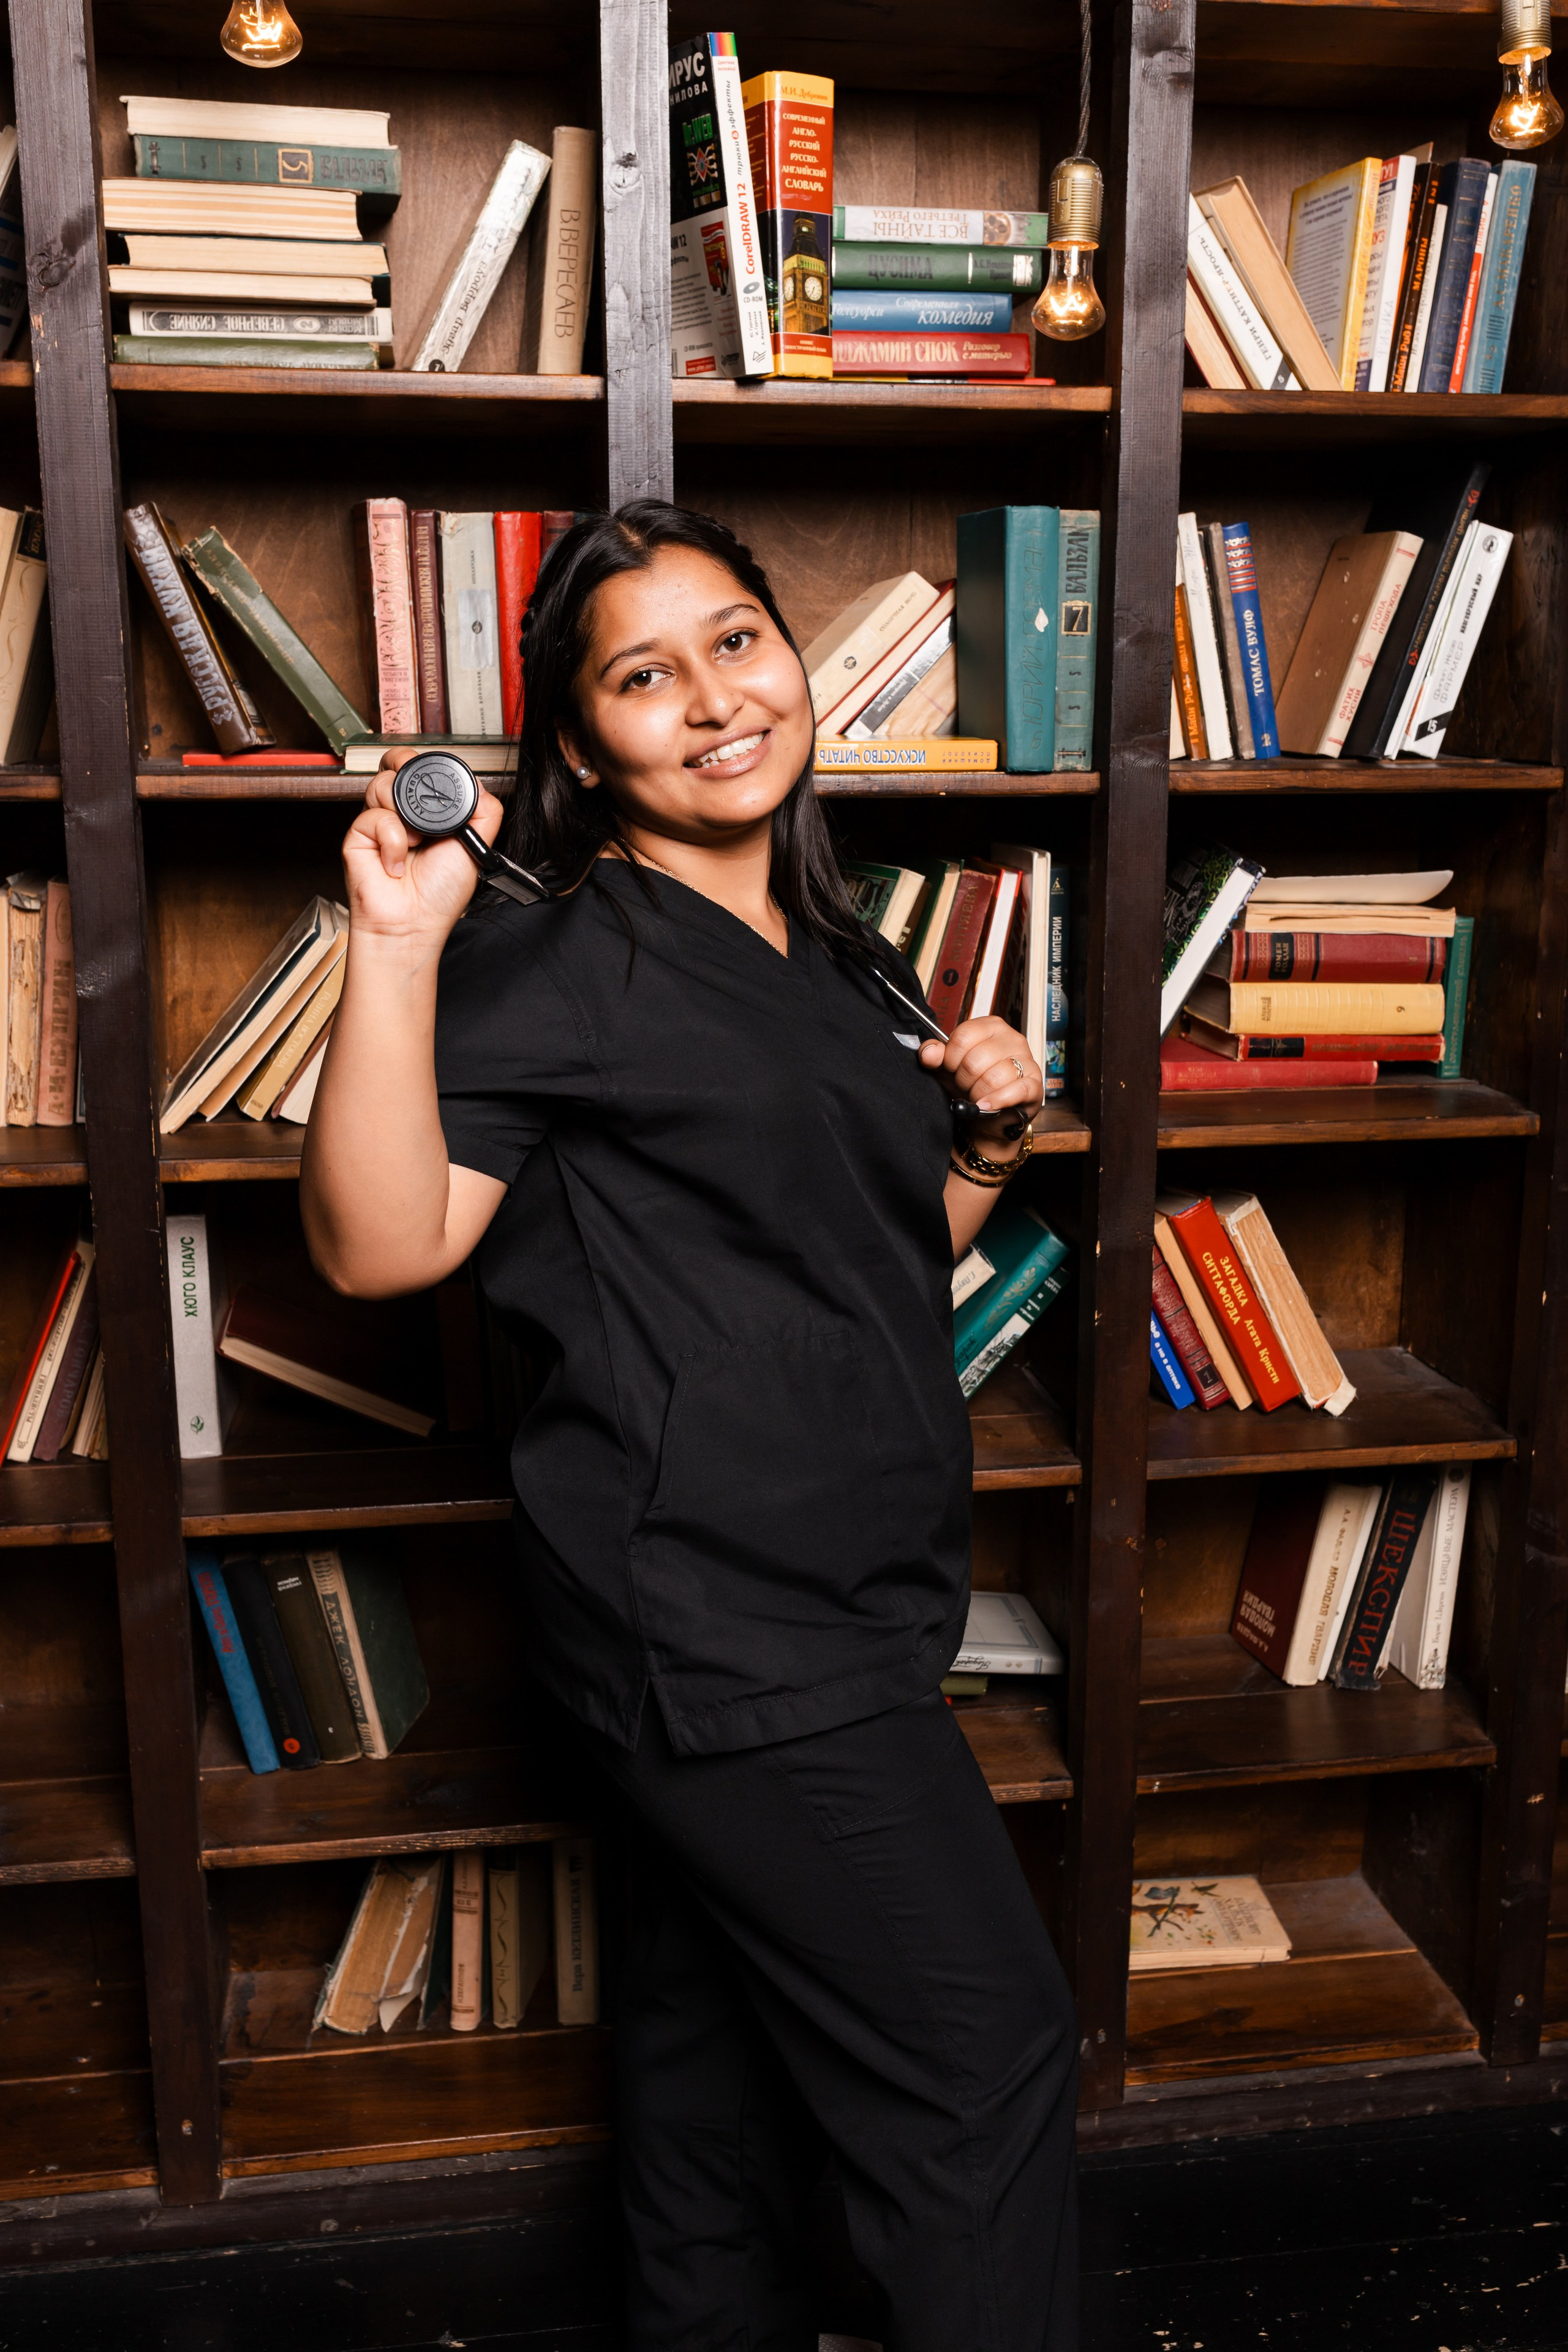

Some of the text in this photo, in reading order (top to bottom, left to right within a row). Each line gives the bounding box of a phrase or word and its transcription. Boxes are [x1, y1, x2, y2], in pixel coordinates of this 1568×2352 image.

[726, 80, 736, 129] эффекты
[782, 113, 826, 126] СОВРЕМЕННЫЙ
[789, 140, 820, 151] РУССКИЙ
[792, 127, 817, 137] АНГЛО-
[320, 155, 388, 184] БАЛЬЗАК
[781, 165, 827, 179] АНГЛИЙСКИЙ
[790, 153, 818, 164] РУССКО-
[737, 183, 746, 198] 12
[785, 178, 824, 192] СЛОВАРЬ
[1369, 173, 1379, 209] Измени
[739, 202, 755, 274] CorelDRAW
[873, 222, 968, 239] ВСЕ ТАЙНЫ
[867, 254, 933, 281] ЦУСИМА
[441, 260, 487, 355] Эдгар Берроуз
[895, 296, 960, 310] Современная
[918, 303, 995, 326] комедия
[1393, 355, 1408, 386] Майн
[1412, 238, 1428, 290] МАРОНЫ
[1463, 299, 1473, 325] мешает
[170, 314, 285, 332] СЕВЕРНОЕ СИЯНИЕ
[1460, 326, 1469, 344] быть
[914, 340, 960, 363] СПОК
[962, 341, 1001, 352] Разговор
[968, 351, 1012, 362] матерью
[1249, 326, 1272, 361] ГЕНРИ
[1455, 344, 1466, 375] богатым
[31, 521, 45, 554] БЛОК
[879, 605, 905, 632] СОЛНЕЧНАЯ
[1071, 606, 1084, 631] 7
[1370, 600, 1387, 631] ТРОПА
[1378, 583, 1402, 635] ПЕШЕХОДА
[1413, 603, 1436, 649] Народные
[1430, 573, 1447, 603] песни
[140, 547, 230, 711] РУССКАЯ КУХНЯ
[1242, 609, 1265, 696] ТОМАС ВУЛФ
[1022, 645, 1044, 726] ЮРИЙ
[1434, 640, 1470, 704] ФАРМЕР
[1338, 687, 1355, 720] ФАТИХ
[1346, 689, 1362, 722] ХУСНИ
[1186, 707, 1198, 735] Майн
[1427, 720, 1438, 734] 15
[818, 748, 926, 766] ИСКУССТВО ЧИТАТЬ
[941, 756, 991, 765] ДОМАШНИЙ
[409, 772, 425, 816] QUALITY
[449, 772, 464, 811] ASSURE
[950, 884, 979, 963] КОПТЯЕВА
[1050, 916, 1063, 1022] НАСЛЕДНИК ИМПЕРИИ
[1449, 935, 1468, 1064] ОРФОГРАФИЧЕСКИЙ СЛОВАРЬ
[275, 989, 332, 1070] ГАЛИНА ВОСТОКОВА
[180, 1236, 198, 1317] ХЮГО КЛАУС
[1202, 1251, 1242, 1326] СИТТАФОРДА
[1219, 1256, 1250, 1307] ЗАГАДКА
[1244, 1318, 1280, 1384] Агата Кристи
[55, 1338, 88, 1420] ГОНЧАРОВ
[1165, 1364, 1182, 1390] аптеке
[1443, 1486, 1460, 1532] МАСТЕРА
[1436, 1535, 1455, 1586] ИЗЯЩНЫЕ
[1242, 1589, 1275, 1620] ГВАРДИЯ
[1317, 1566, 1340, 1616] МОЛОДАЯ
[1348, 1509, 1416, 1676] ШЕКСПИР
[1240, 1605, 1276, 1637] МОЛОДАЯ
[1306, 1620, 1325, 1665] ГВАРДИЯ
[325, 1600, 364, 1719] ДЖЕК ЛОНДОН
[571, 1964, 583, 1992] Вера
